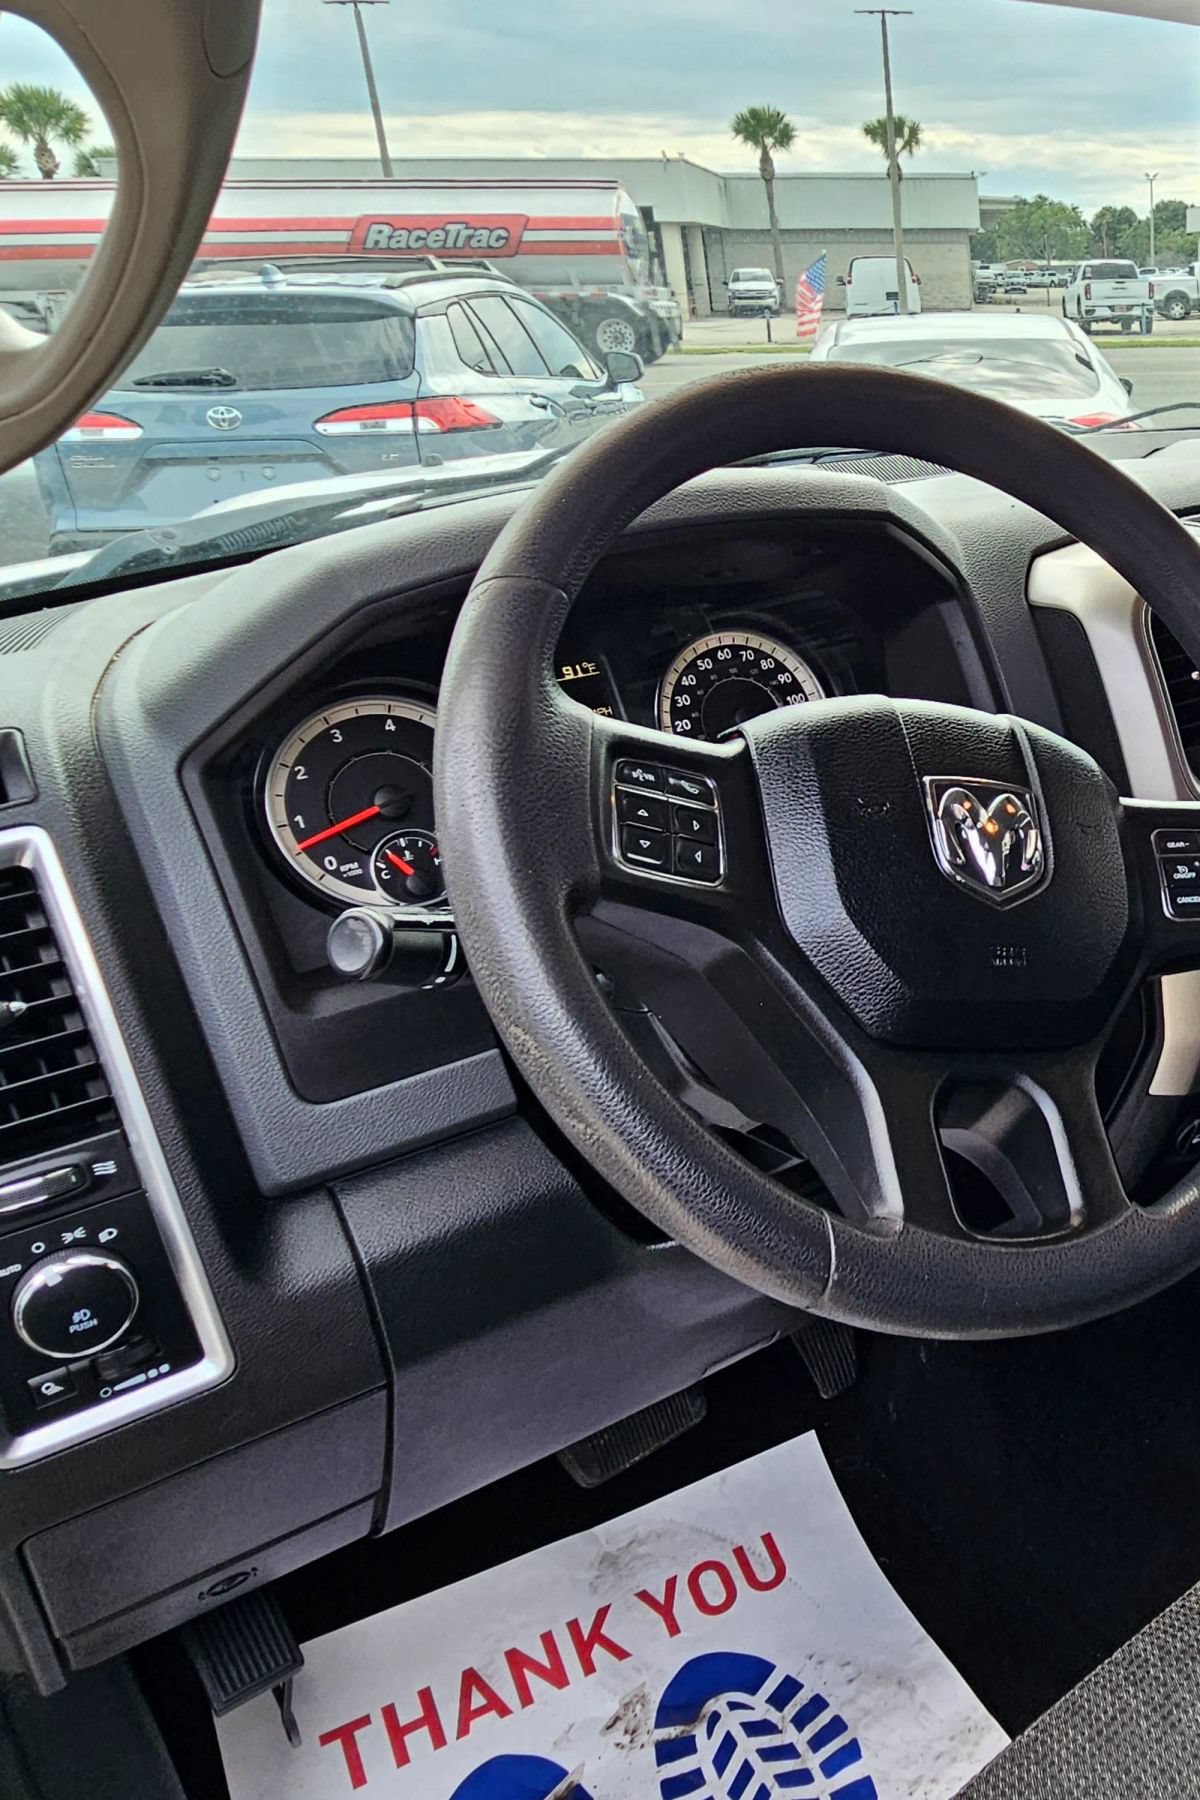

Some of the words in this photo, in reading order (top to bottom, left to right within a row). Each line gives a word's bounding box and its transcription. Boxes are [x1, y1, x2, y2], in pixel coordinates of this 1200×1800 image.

[364, 222, 511, 250] RaceTrac
[717, 648, 732, 660] 60
[740, 650, 754, 662] 70
[697, 658, 713, 671] 50
[760, 658, 775, 670] 80
[681, 674, 696, 686] 40
[777, 672, 792, 685] 90
[674, 694, 691, 707] 30
[786, 693, 806, 706] 100
[384, 718, 396, 732] 4
[674, 719, 691, 732] 20
[330, 729, 343, 743] 3
[294, 765, 308, 780] 2
[293, 815, 306, 829] 1
[323, 855, 338, 871] 0
[381, 870, 391, 879] C
[69, 1318, 98, 1334] PUSH
[319, 1604, 632, 1790] THANK
[633, 1531, 789, 1638] YOU
